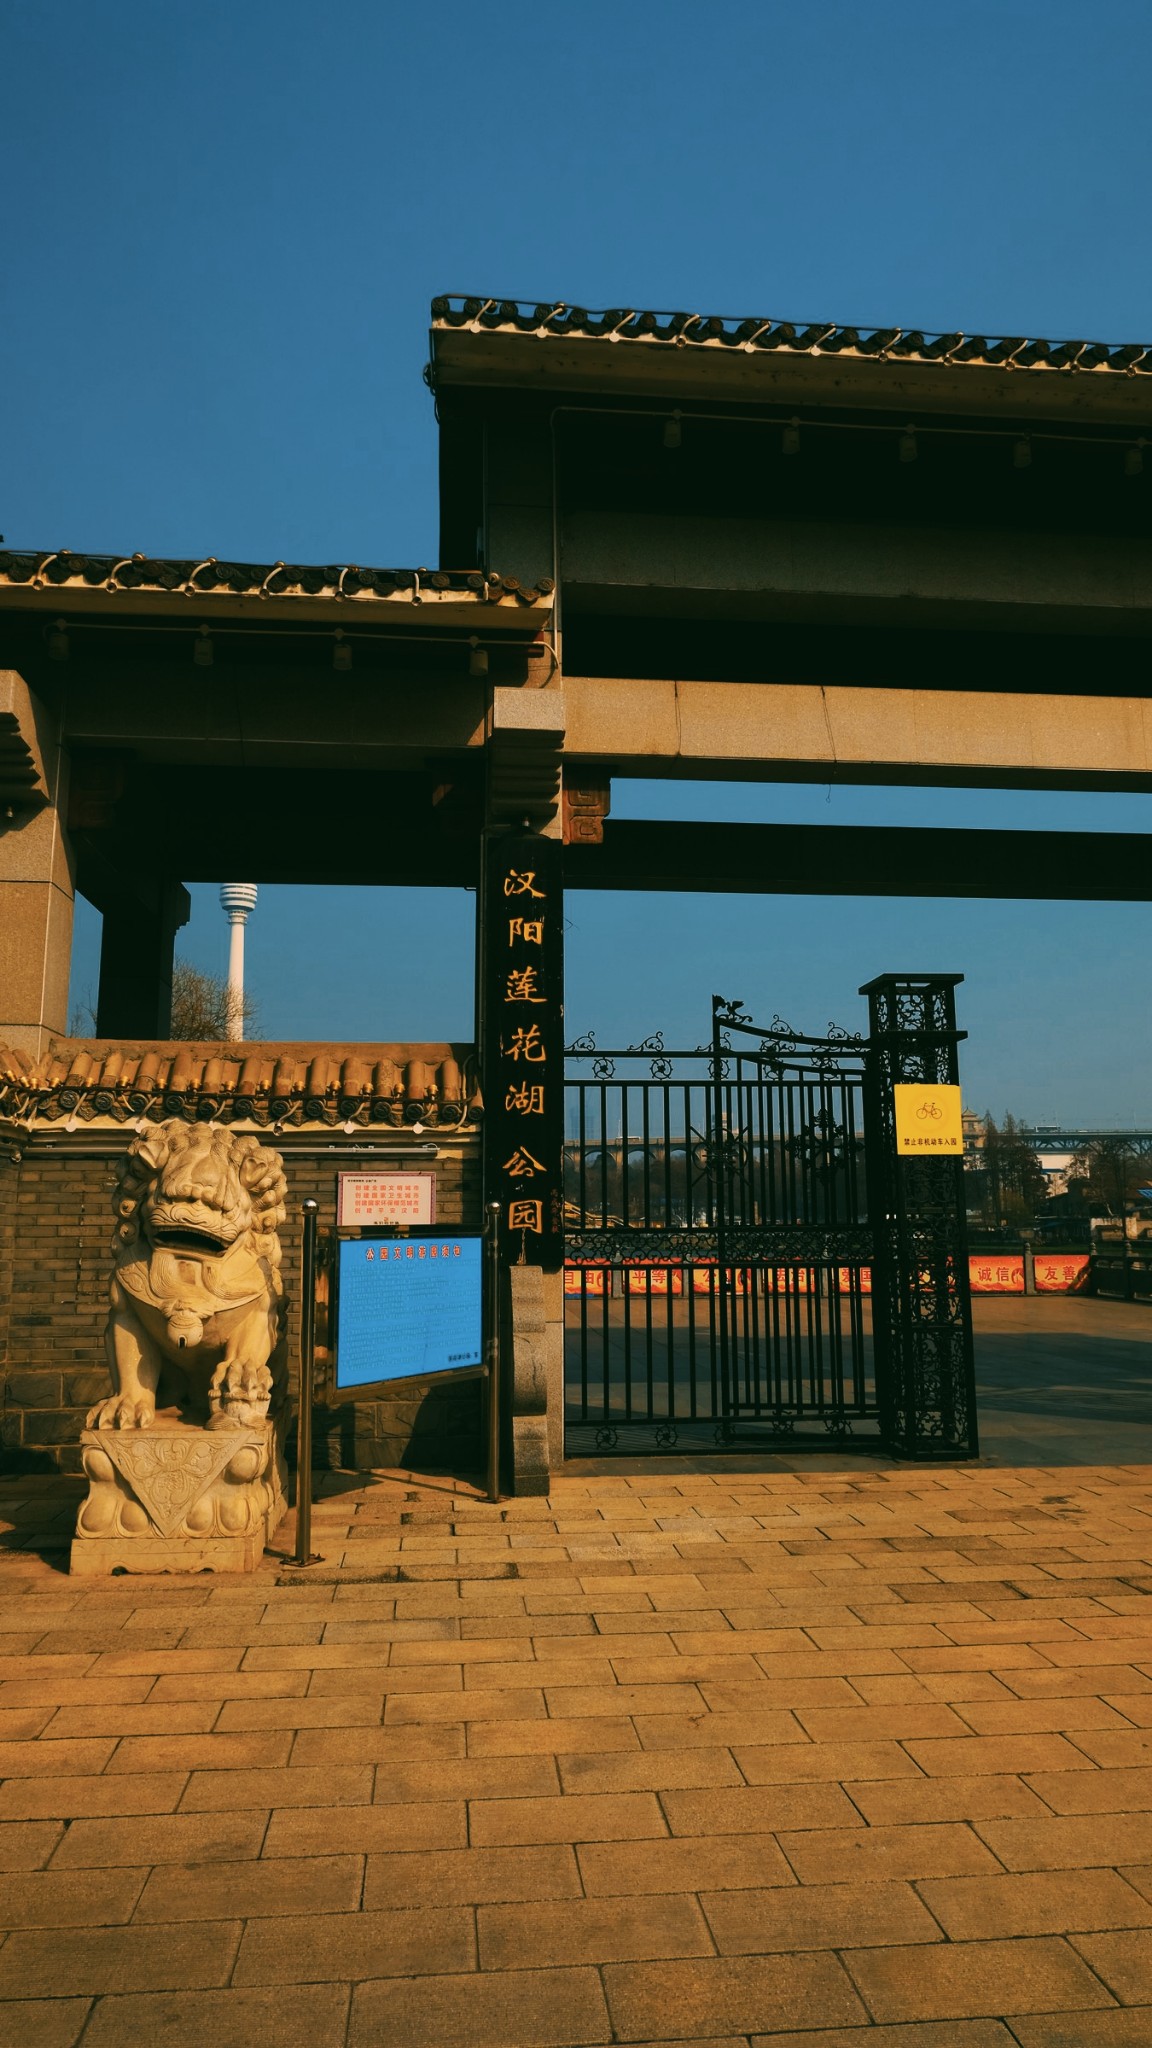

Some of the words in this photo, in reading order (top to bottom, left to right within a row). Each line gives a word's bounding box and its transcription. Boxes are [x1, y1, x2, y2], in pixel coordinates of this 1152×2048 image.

[503, 869, 548, 1234] 汉阳莲花湖公园
[904, 1138, 957, 1146] 禁止非机动车入园
[978, 1267, 1010, 1282] 诚信
[1044, 1266, 1076, 1281] 友善
